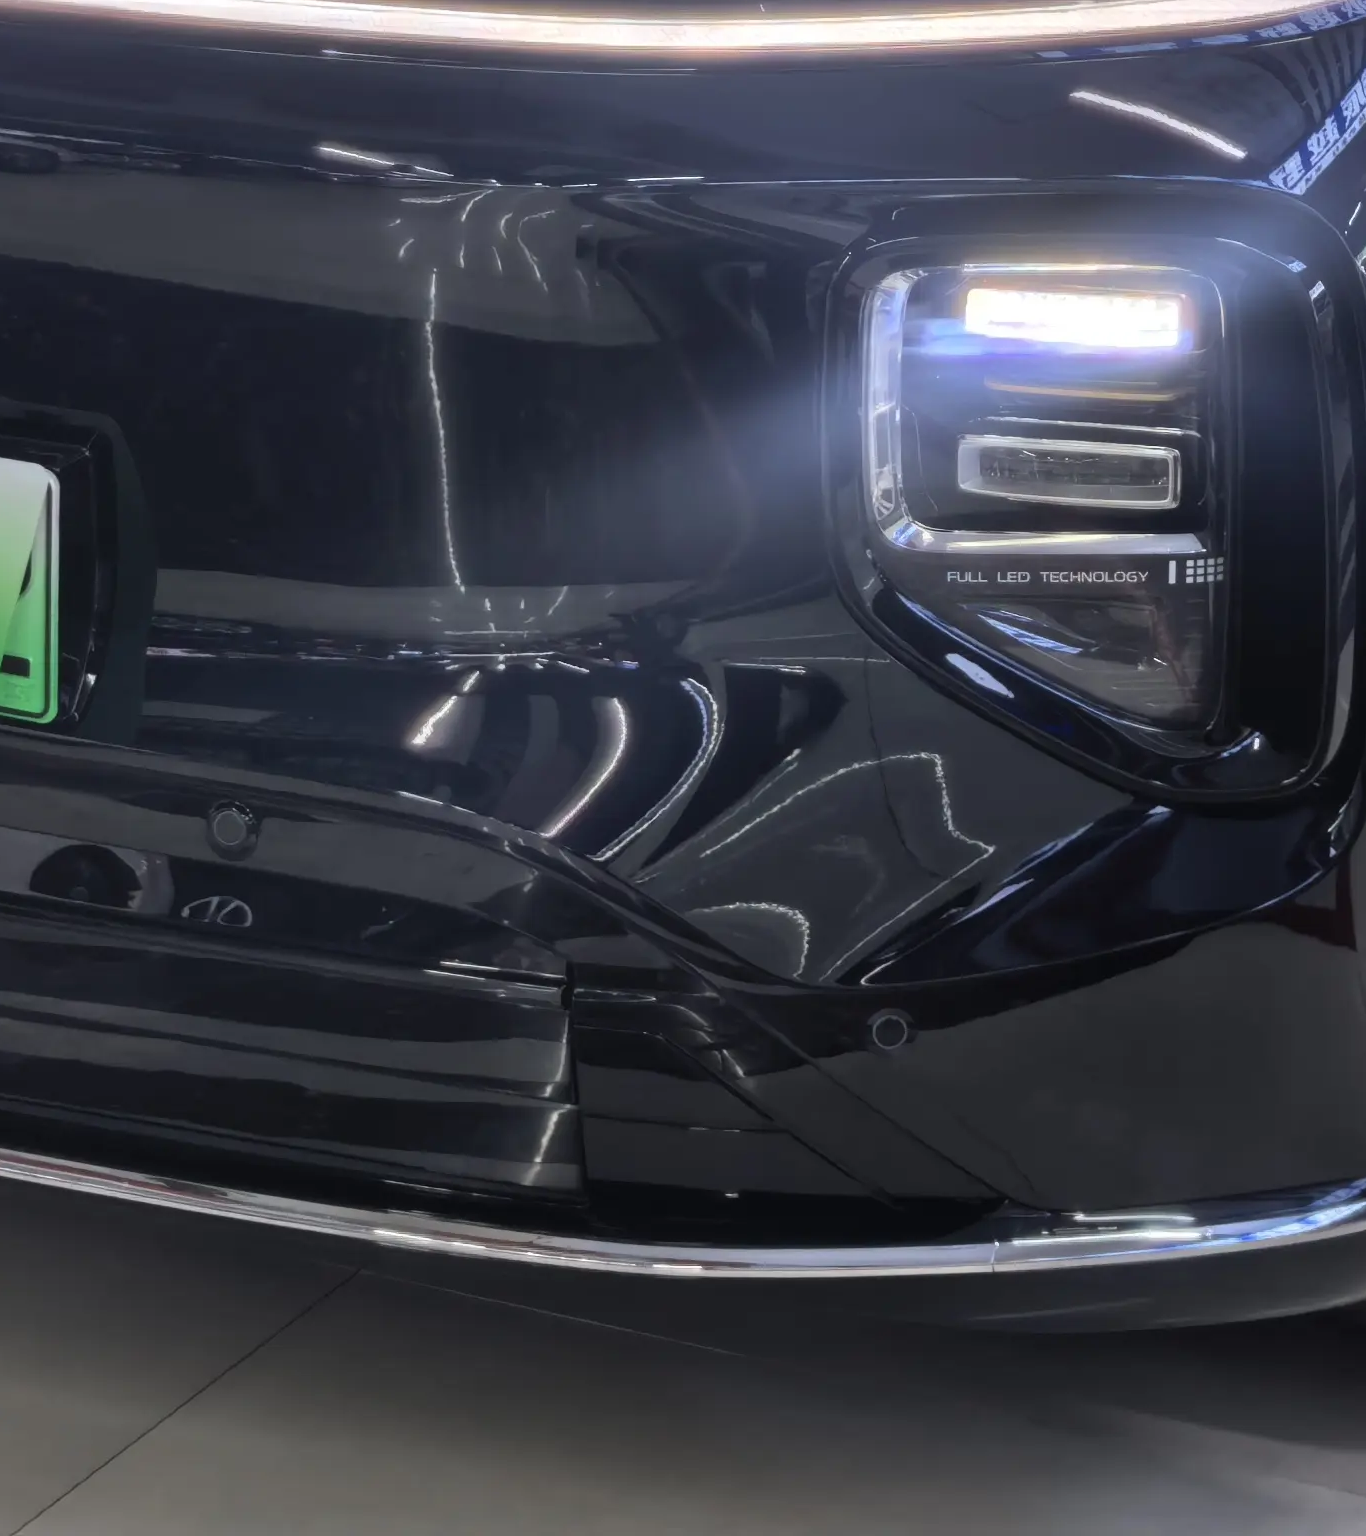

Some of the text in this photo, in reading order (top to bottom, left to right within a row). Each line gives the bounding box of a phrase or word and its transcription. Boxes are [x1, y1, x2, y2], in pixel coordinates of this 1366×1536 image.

[946, 570, 1149, 583] FULL LED TECHNOLOGY
